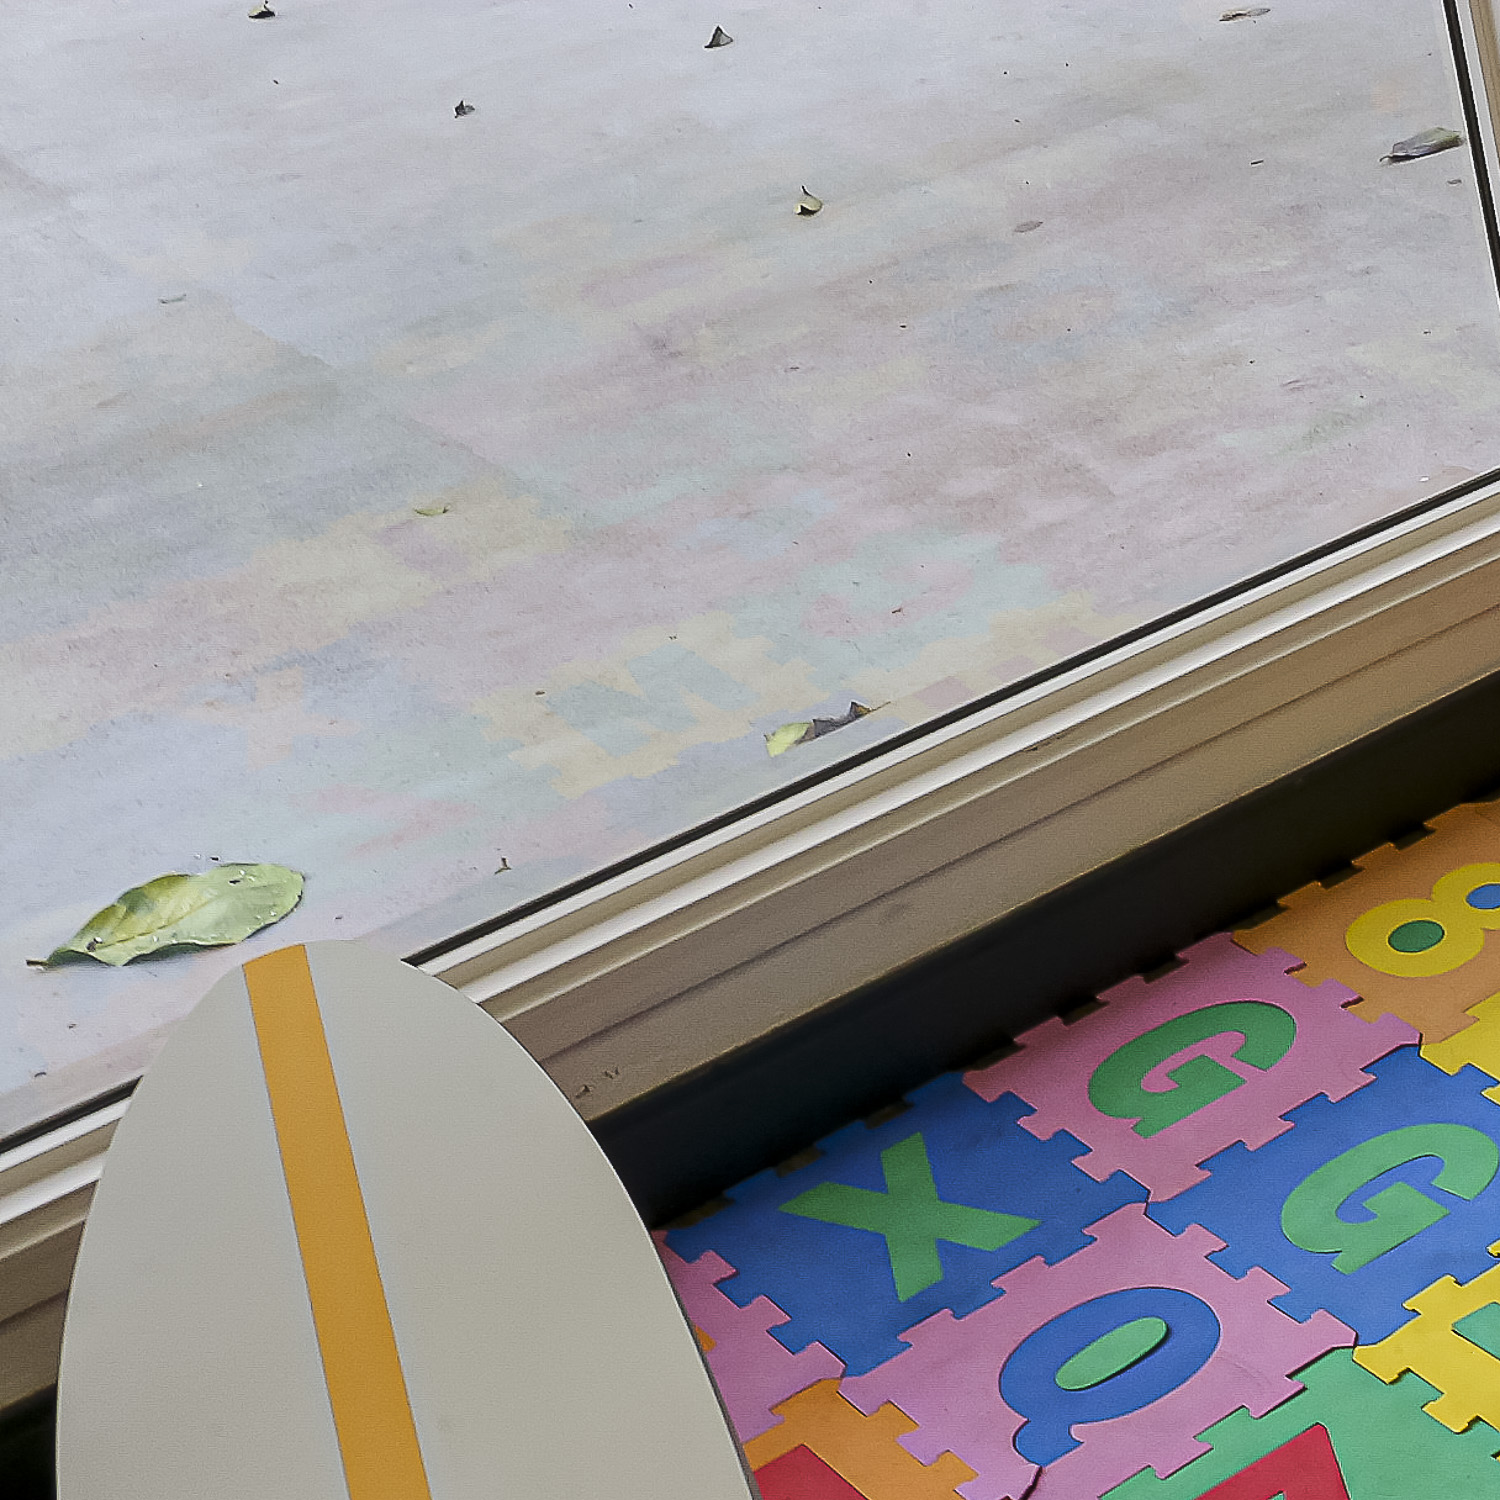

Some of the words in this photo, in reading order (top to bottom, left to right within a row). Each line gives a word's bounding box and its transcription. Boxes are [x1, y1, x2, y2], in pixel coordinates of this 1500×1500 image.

[1087, 1002, 1296, 1139] G
[778, 1131, 1040, 1302] X
[1281, 1123, 1499, 1275] G
[998, 1287, 1221, 1465] Q
